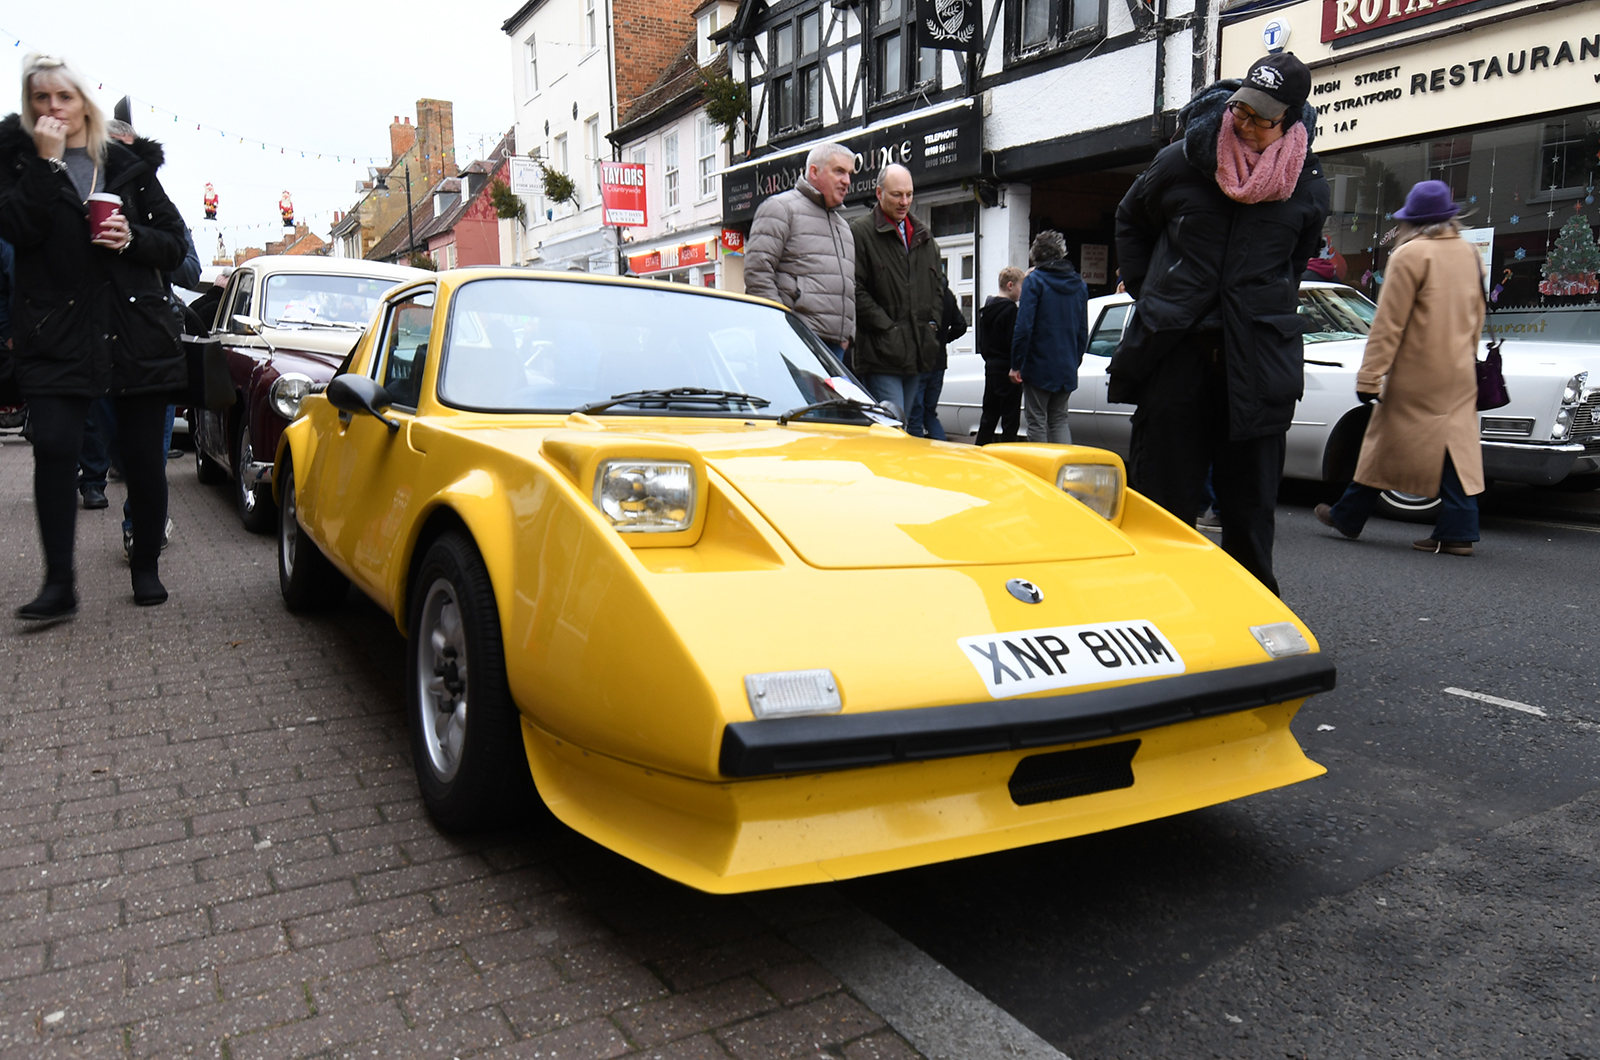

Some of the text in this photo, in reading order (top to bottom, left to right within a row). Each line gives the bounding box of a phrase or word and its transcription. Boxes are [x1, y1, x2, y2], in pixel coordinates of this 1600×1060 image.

[1410, 34, 1600, 95] RESTAURAN
[1313, 66, 1401, 96] HIGH STREET
[1315, 88, 1402, 115] NY STRATFORD
[1333, 119, 1358, 133] 1AF
[923, 127, 959, 145] TELEPHONE
[603, 166, 644, 186] TAYLORS
[856, 178, 877, 192] CUIS
[606, 185, 642, 194] Countrywide
[725, 232, 741, 240] JUST
[645, 255, 660, 267] ESTATE
[681, 248, 699, 260] AGENTS
[1481, 319, 1548, 333] aurant
[969, 626, 1175, 685] XNP 811M
